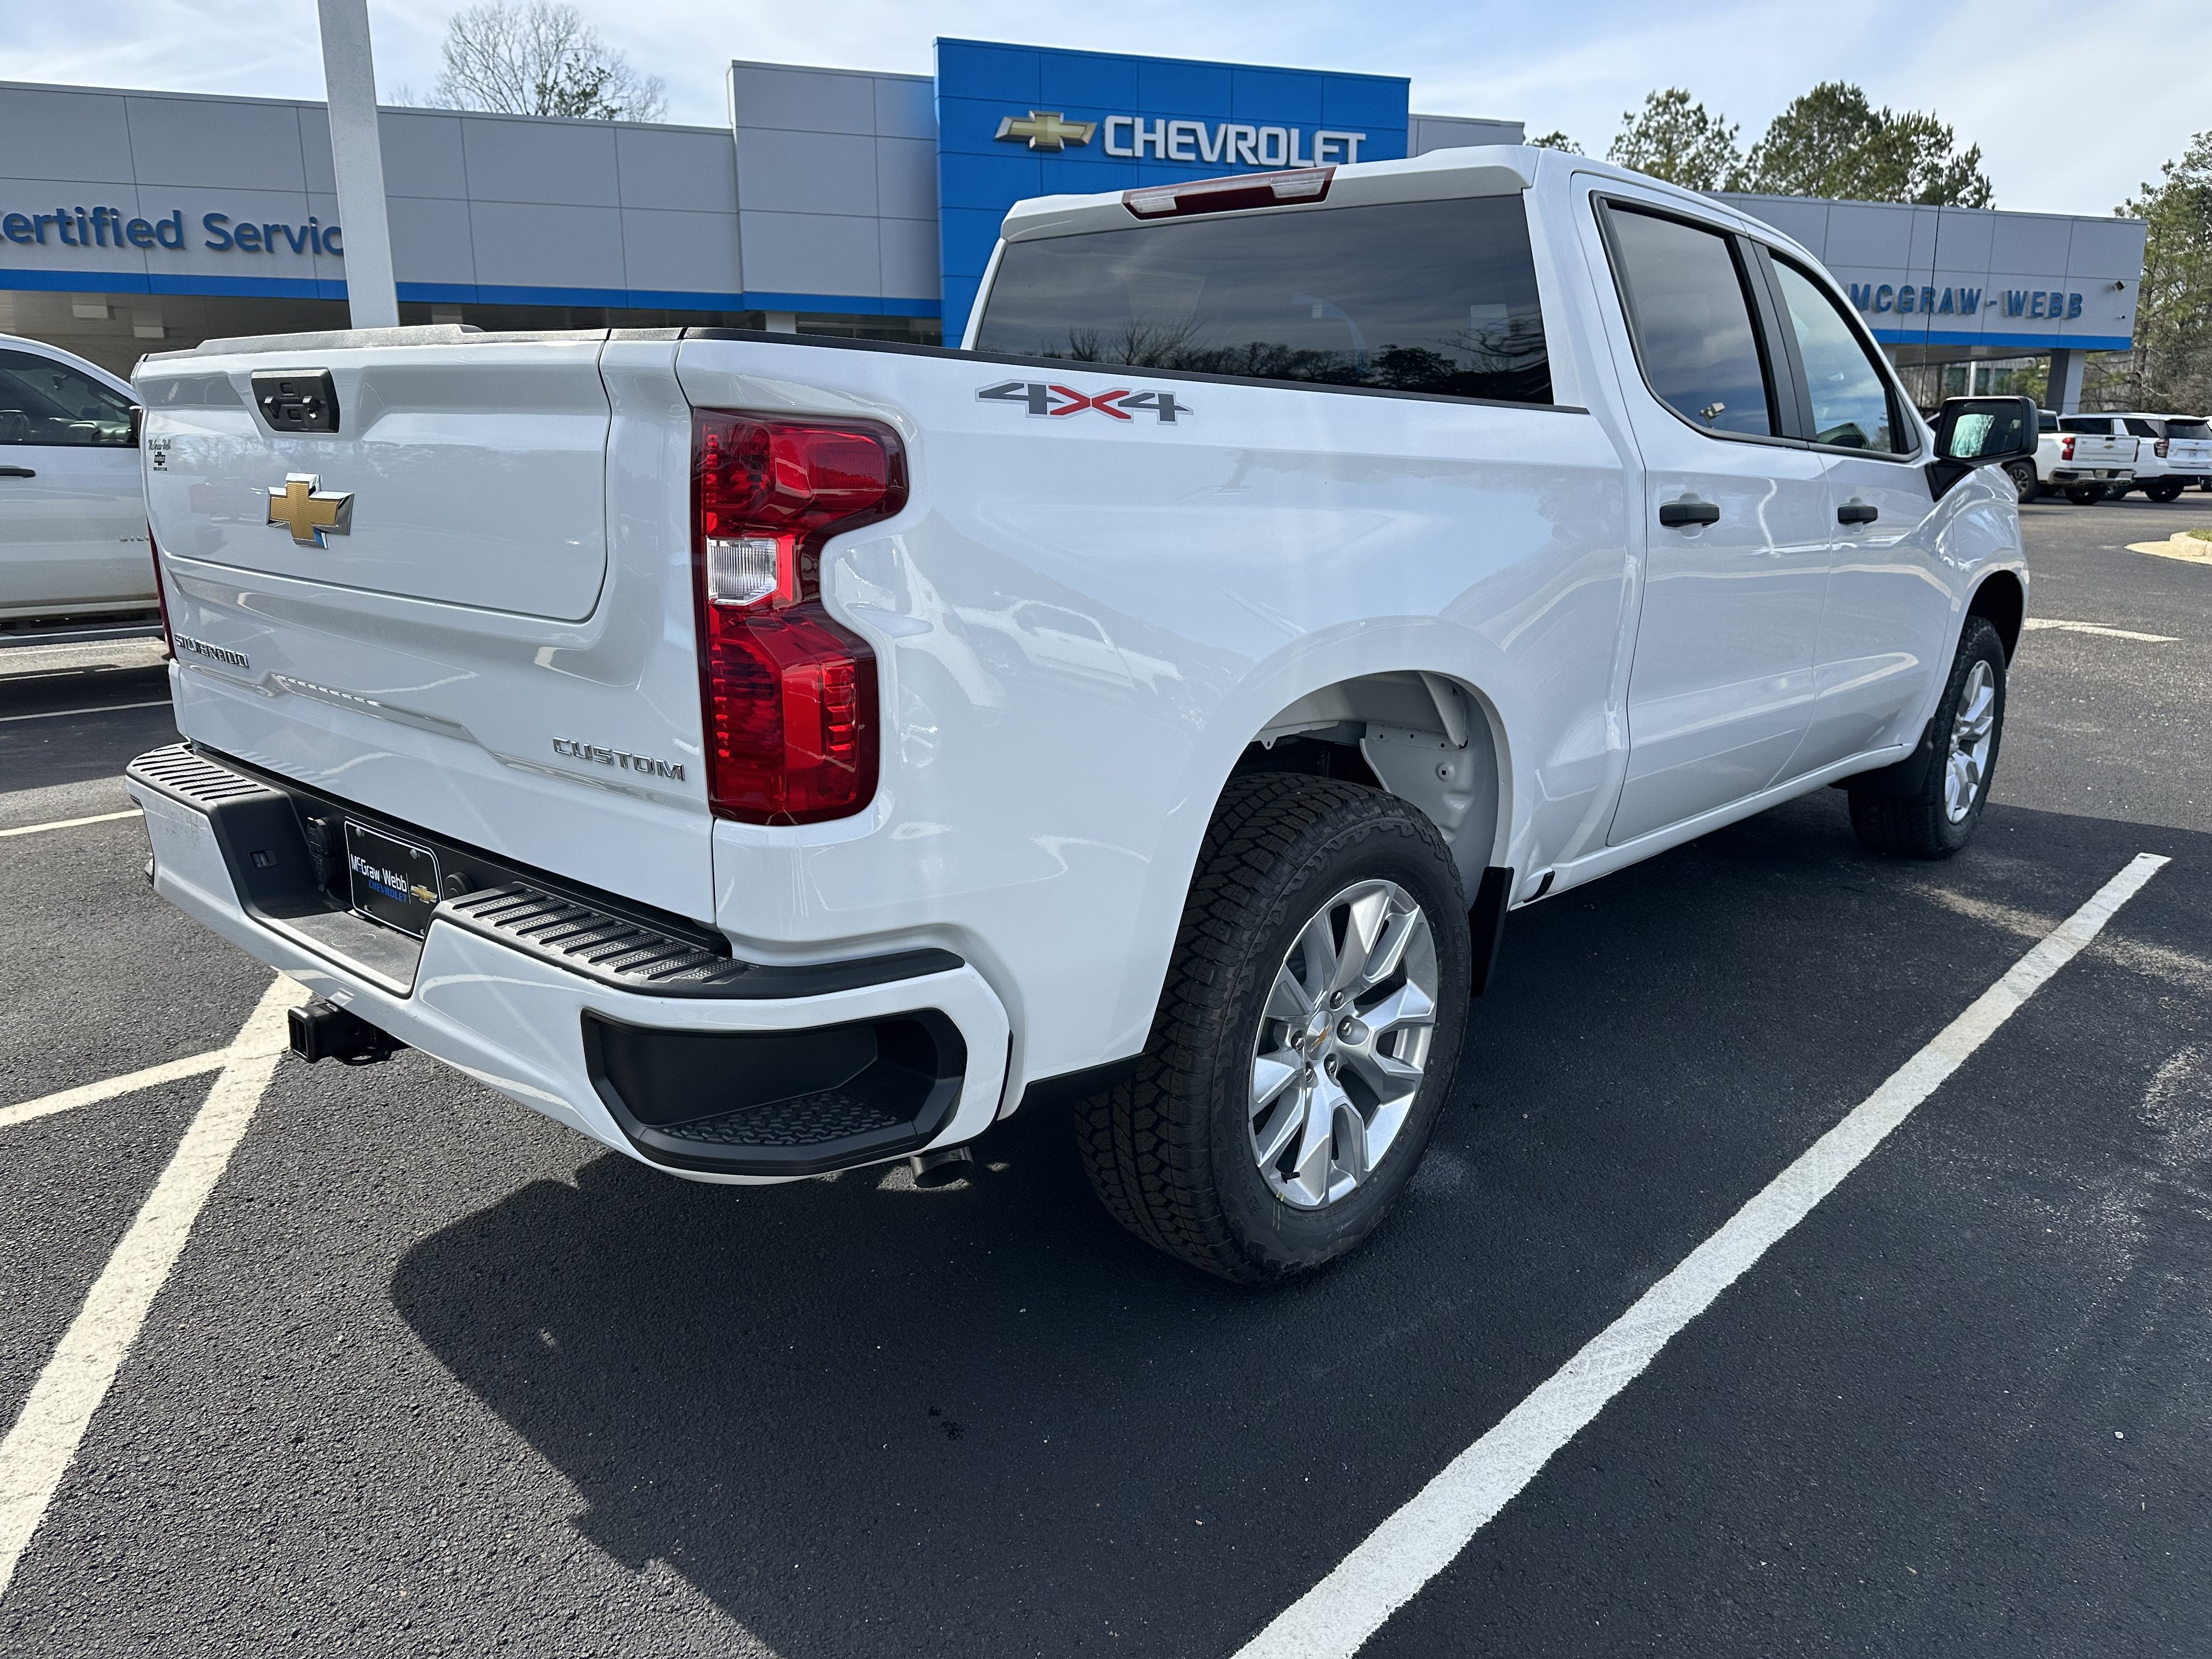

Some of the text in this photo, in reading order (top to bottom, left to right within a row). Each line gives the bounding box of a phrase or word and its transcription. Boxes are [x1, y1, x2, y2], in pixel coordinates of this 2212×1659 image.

[1103, 115, 1367, 167] CHEVROLET
[0, 206, 344, 256] ertified Servic
[174, 633, 250, 668] SILVERADO
[552, 737, 685, 781] CUSTOM
[368, 879, 408, 903] CHEVROLET
